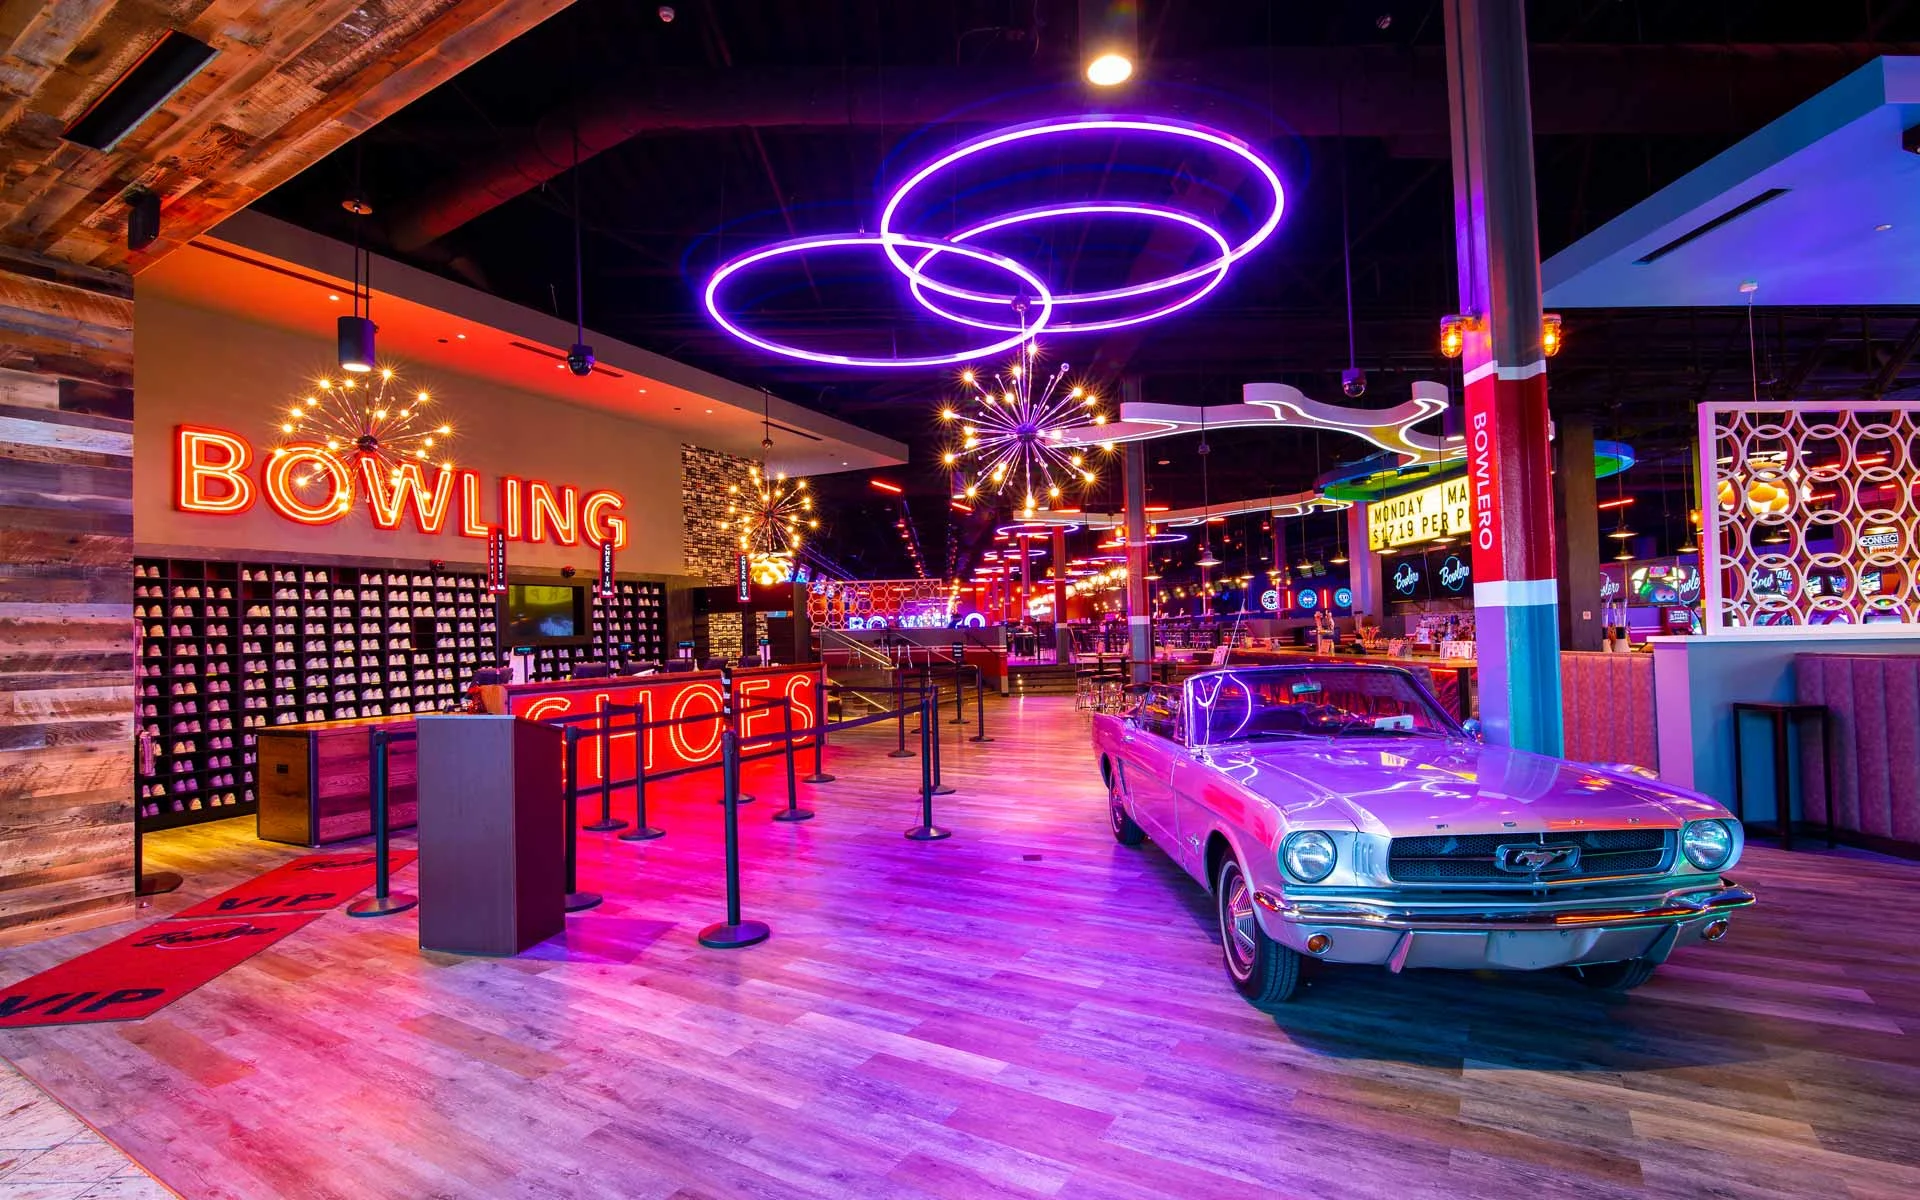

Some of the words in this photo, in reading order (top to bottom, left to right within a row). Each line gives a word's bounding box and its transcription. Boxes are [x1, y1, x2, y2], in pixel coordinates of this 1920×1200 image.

[174, 424, 628, 551] BOWLING
[1473, 411, 1493, 550] BOWLERO
[1375, 496, 1423, 524] MONDAY
[1422, 514, 1449, 533] PER
[604, 576, 610, 588] IN
[1439, 560, 1470, 586] Bowlero
[525, 674, 814, 779] HOES
[217, 892, 336, 911] VIP
[0, 988, 165, 1018] VIP
